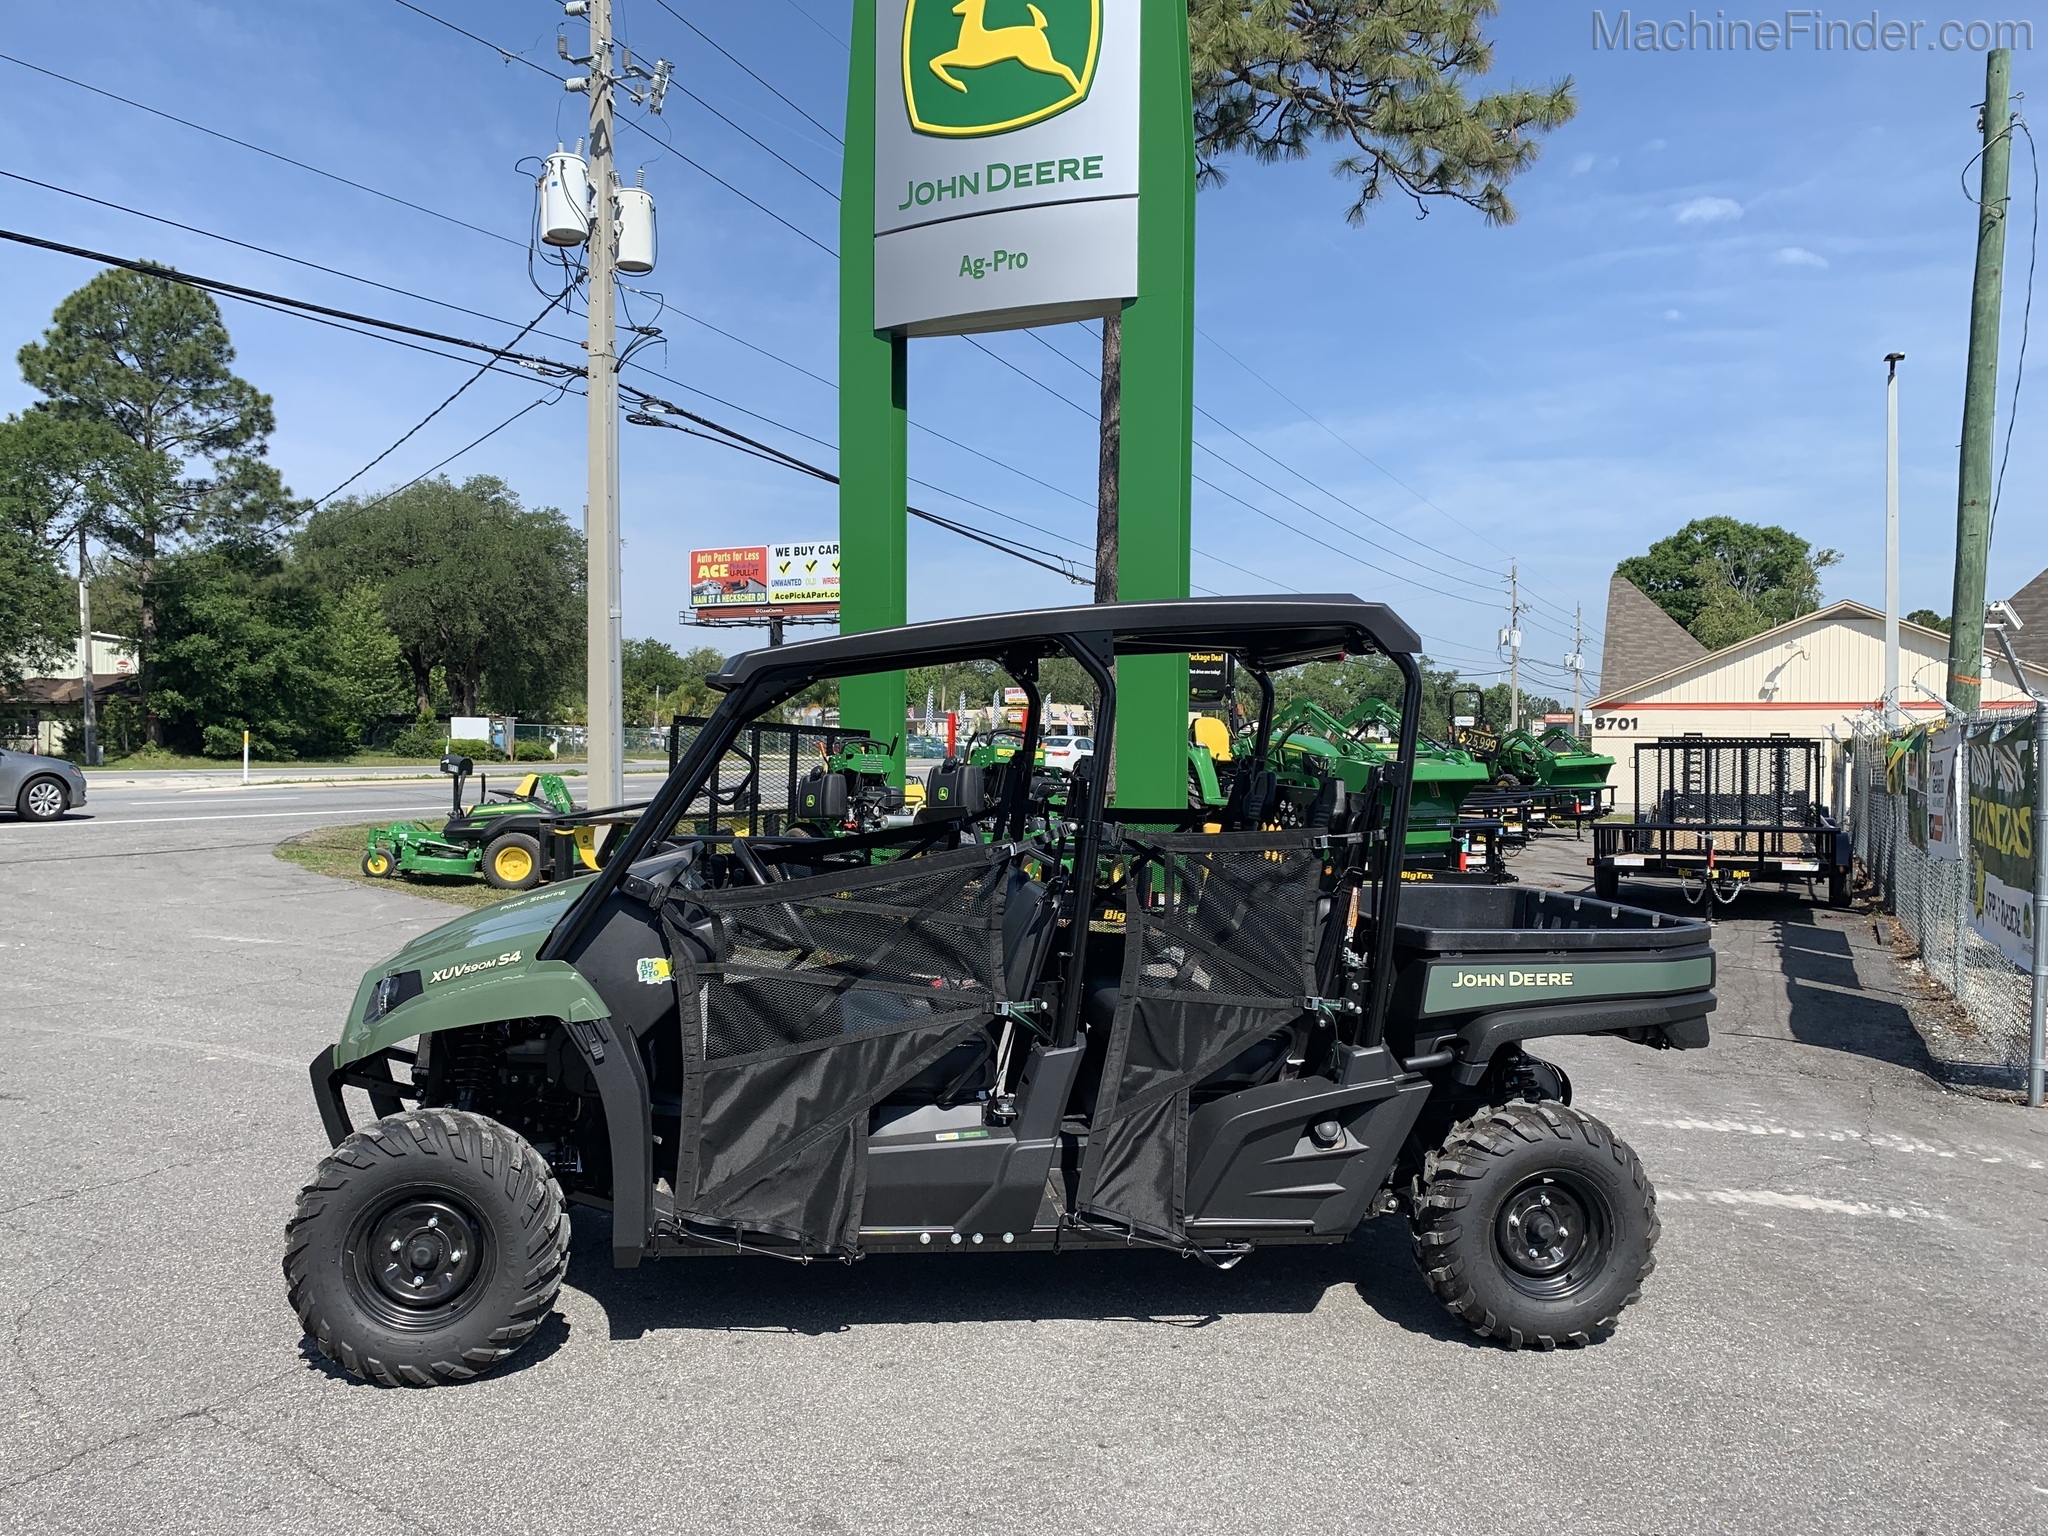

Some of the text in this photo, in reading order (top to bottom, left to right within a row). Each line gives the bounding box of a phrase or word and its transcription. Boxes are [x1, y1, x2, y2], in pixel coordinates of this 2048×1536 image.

[899, 155, 1104, 211] JOHN DEERE
[958, 249, 1029, 280] Ag-Pro
[775, 545, 839, 557] WE BUY CAR
[697, 551, 760, 564] Auto Parts for Less
[697, 563, 729, 579] ACE
[729, 568, 759, 577] U-PULL-IT
[771, 578, 802, 587] UNWANTED
[822, 576, 840, 585] WREC
[693, 595, 708, 604] MAIN
[708, 594, 716, 603] ST
[722, 593, 756, 603] HECKSCHER
[774, 591, 840, 600] AcePickAPart.co
[1211, 653, 1224, 662] Deal
[1595, 717, 1638, 731] 8701
[1400, 871, 1434, 882] BigTex
[500, 890, 567, 911] Power Steering
[1103, 909, 1127, 923] Big
[428, 949, 523, 985] XUV590M S4
[640, 960, 658, 971] Ag-
[641, 969, 660, 979] Pro
[1451, 970, 1574, 988] JOHN DEERE
